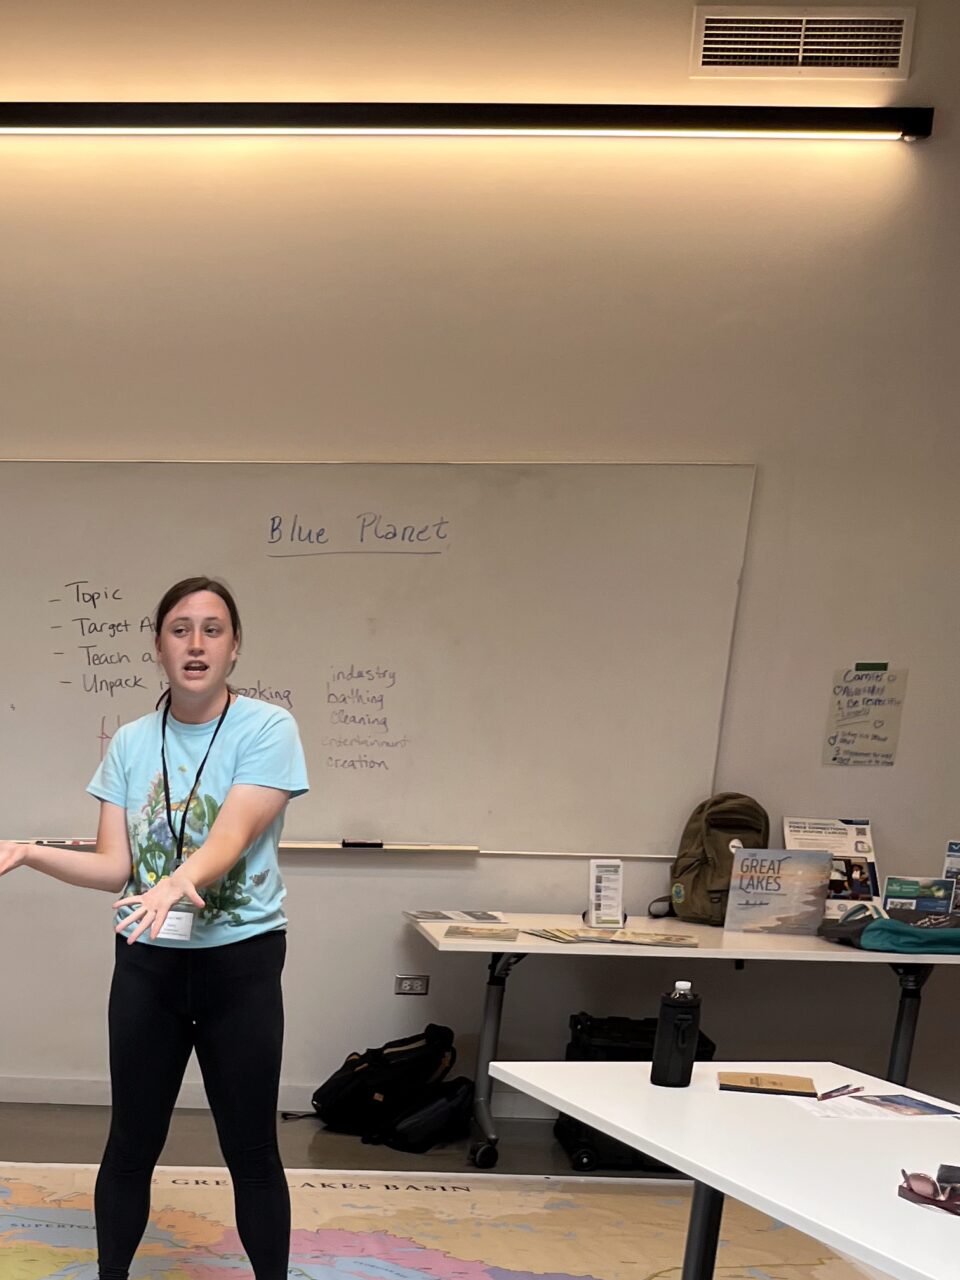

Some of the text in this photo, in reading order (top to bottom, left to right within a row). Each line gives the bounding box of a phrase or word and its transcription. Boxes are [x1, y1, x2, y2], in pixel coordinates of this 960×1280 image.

[268, 512, 450, 544] Blue Planet
[64, 580, 123, 609] Topic
[72, 617, 132, 638] Target
[78, 644, 131, 666] Teach
[82, 674, 148, 698] Unpack
[331, 664, 396, 688] industry
[326, 681, 385, 710] bathing
[326, 754, 389, 770] creation
[740, 856, 792, 875] GREAT
[739, 875, 782, 894] LAKES
[288, 1182, 371, 1190] AKES
[384, 1183, 472, 1193] BASIN
